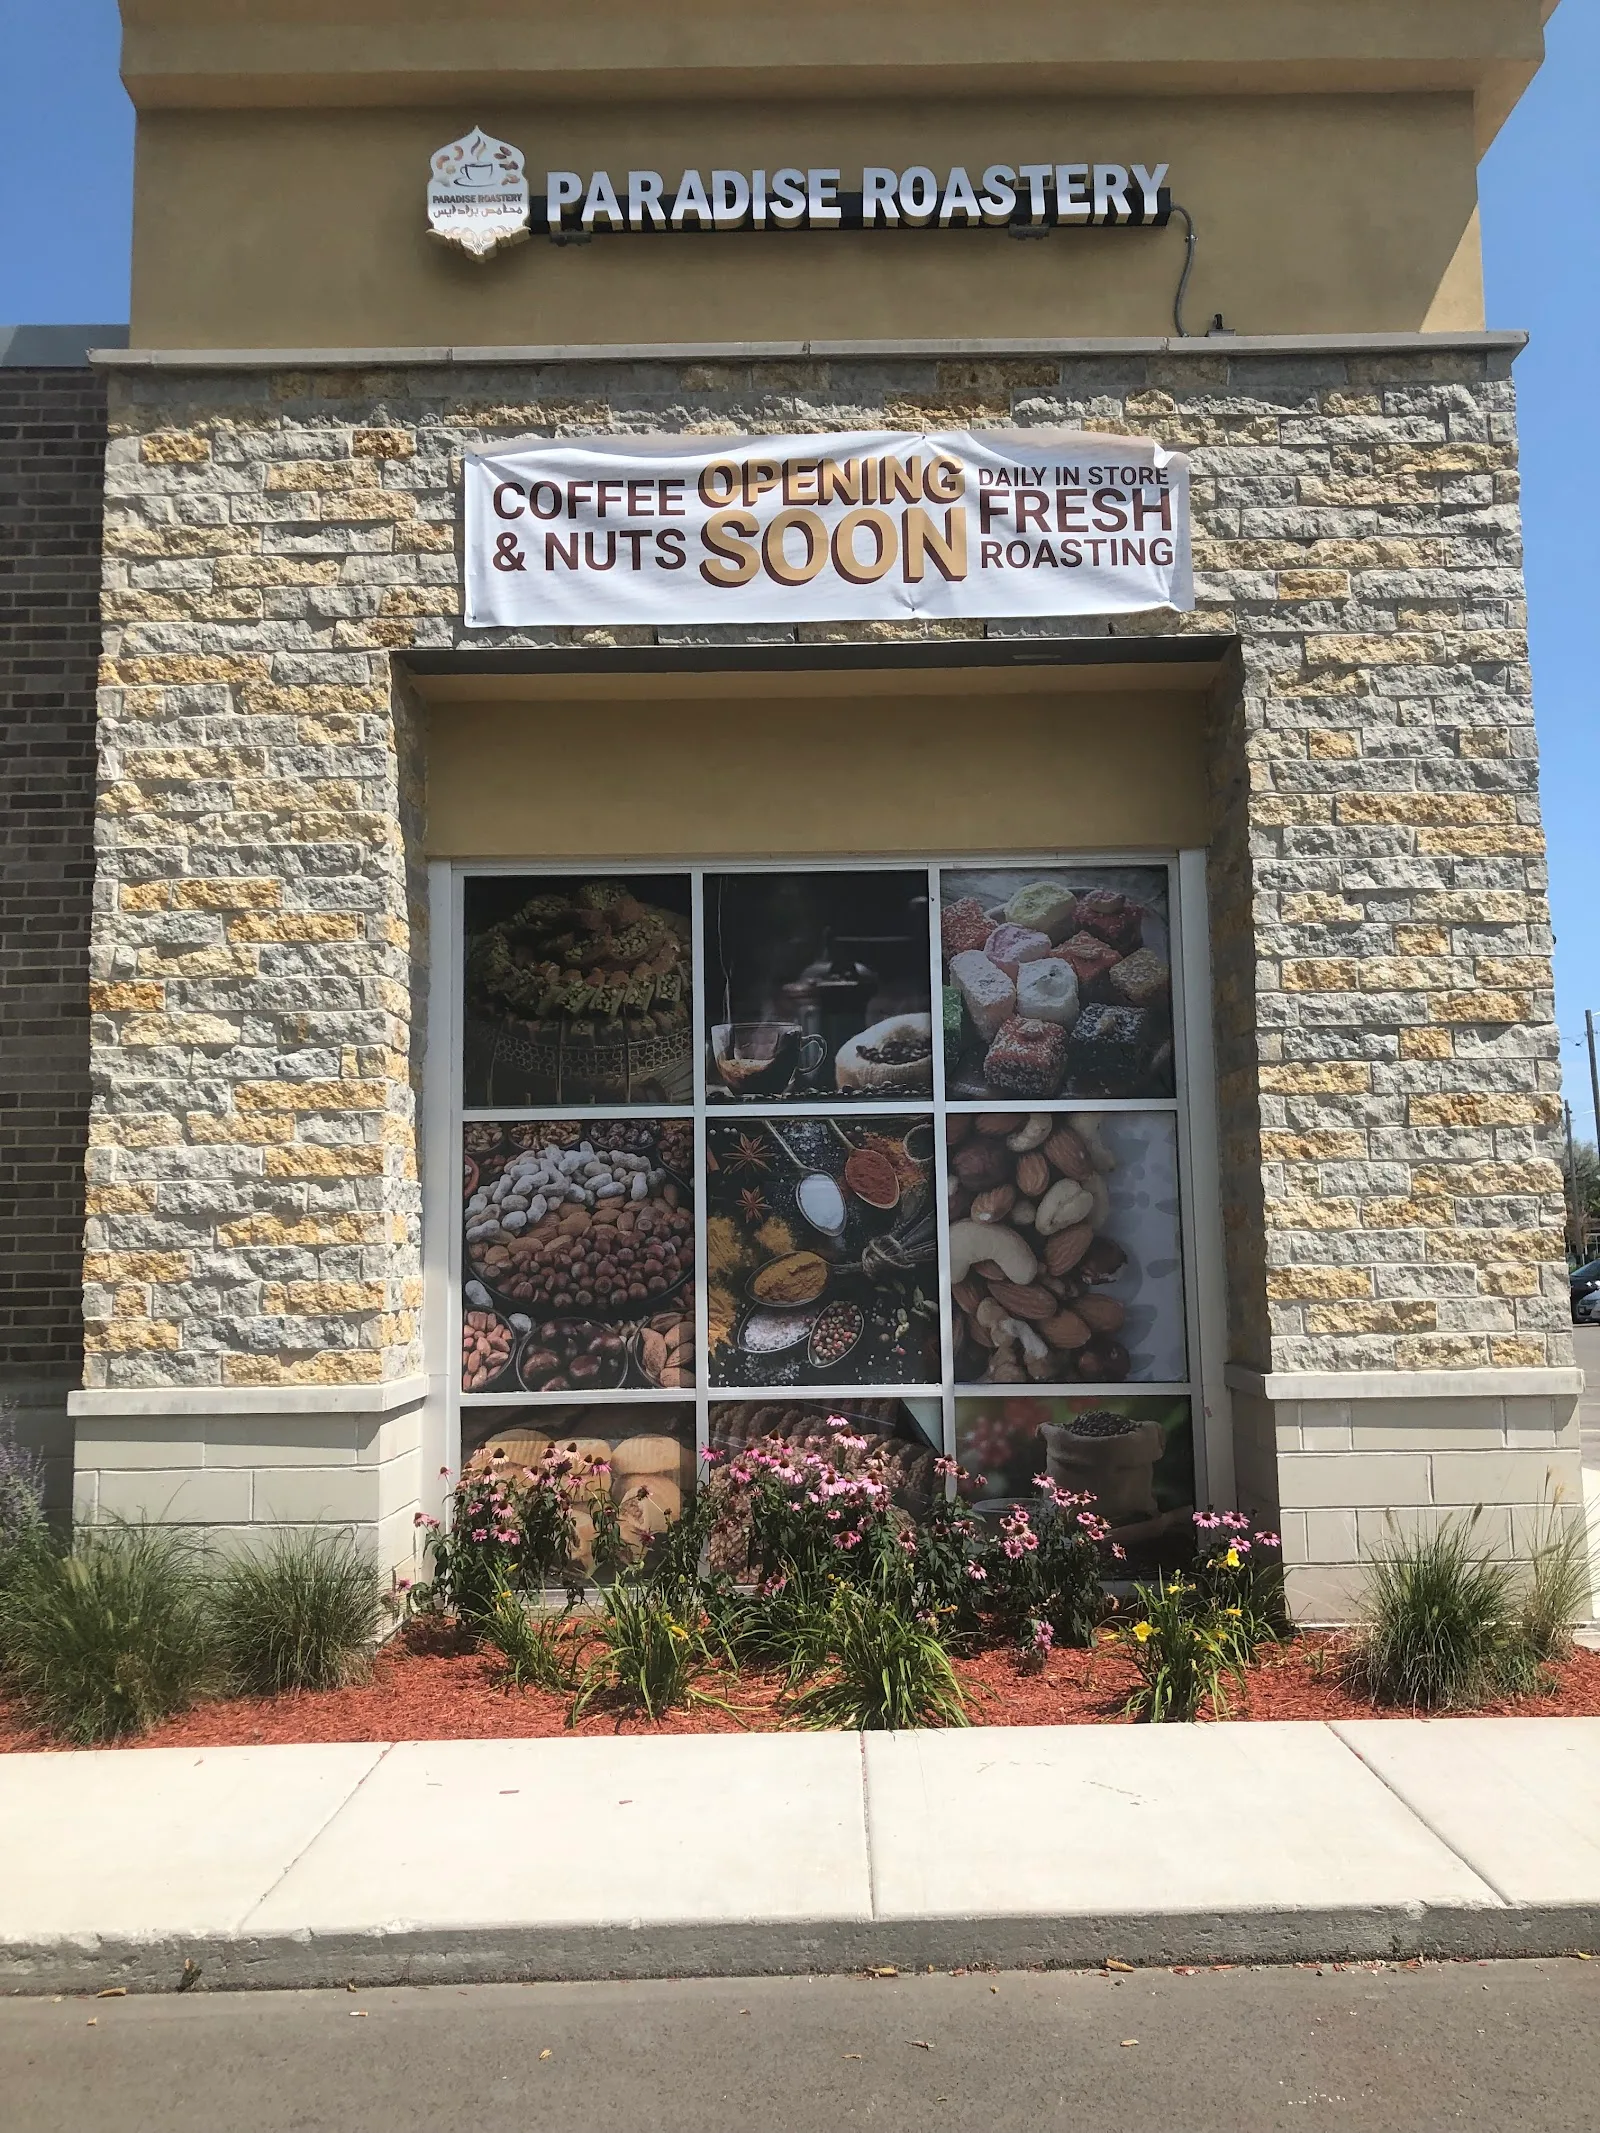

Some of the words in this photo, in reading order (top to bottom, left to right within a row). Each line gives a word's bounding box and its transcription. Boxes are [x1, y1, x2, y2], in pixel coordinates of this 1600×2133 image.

[432, 195, 476, 203] PARADISE
[478, 194, 522, 203] ROASTERY
[547, 168, 841, 221] PARADISE
[862, 164, 1170, 218] ROASTERY
[697, 455, 966, 508] OPENING
[978, 466, 1048, 487] DAILY
[1055, 466, 1081, 486] IN
[1087, 466, 1169, 485] STORE
[493, 479, 686, 520] COFFEE
[979, 487, 1173, 535] FRESH
[492, 532, 527, 572] &
[545, 528, 687, 571] NUTS
[699, 507, 968, 588] SOON
[981, 537, 1174, 569] ROASTING
